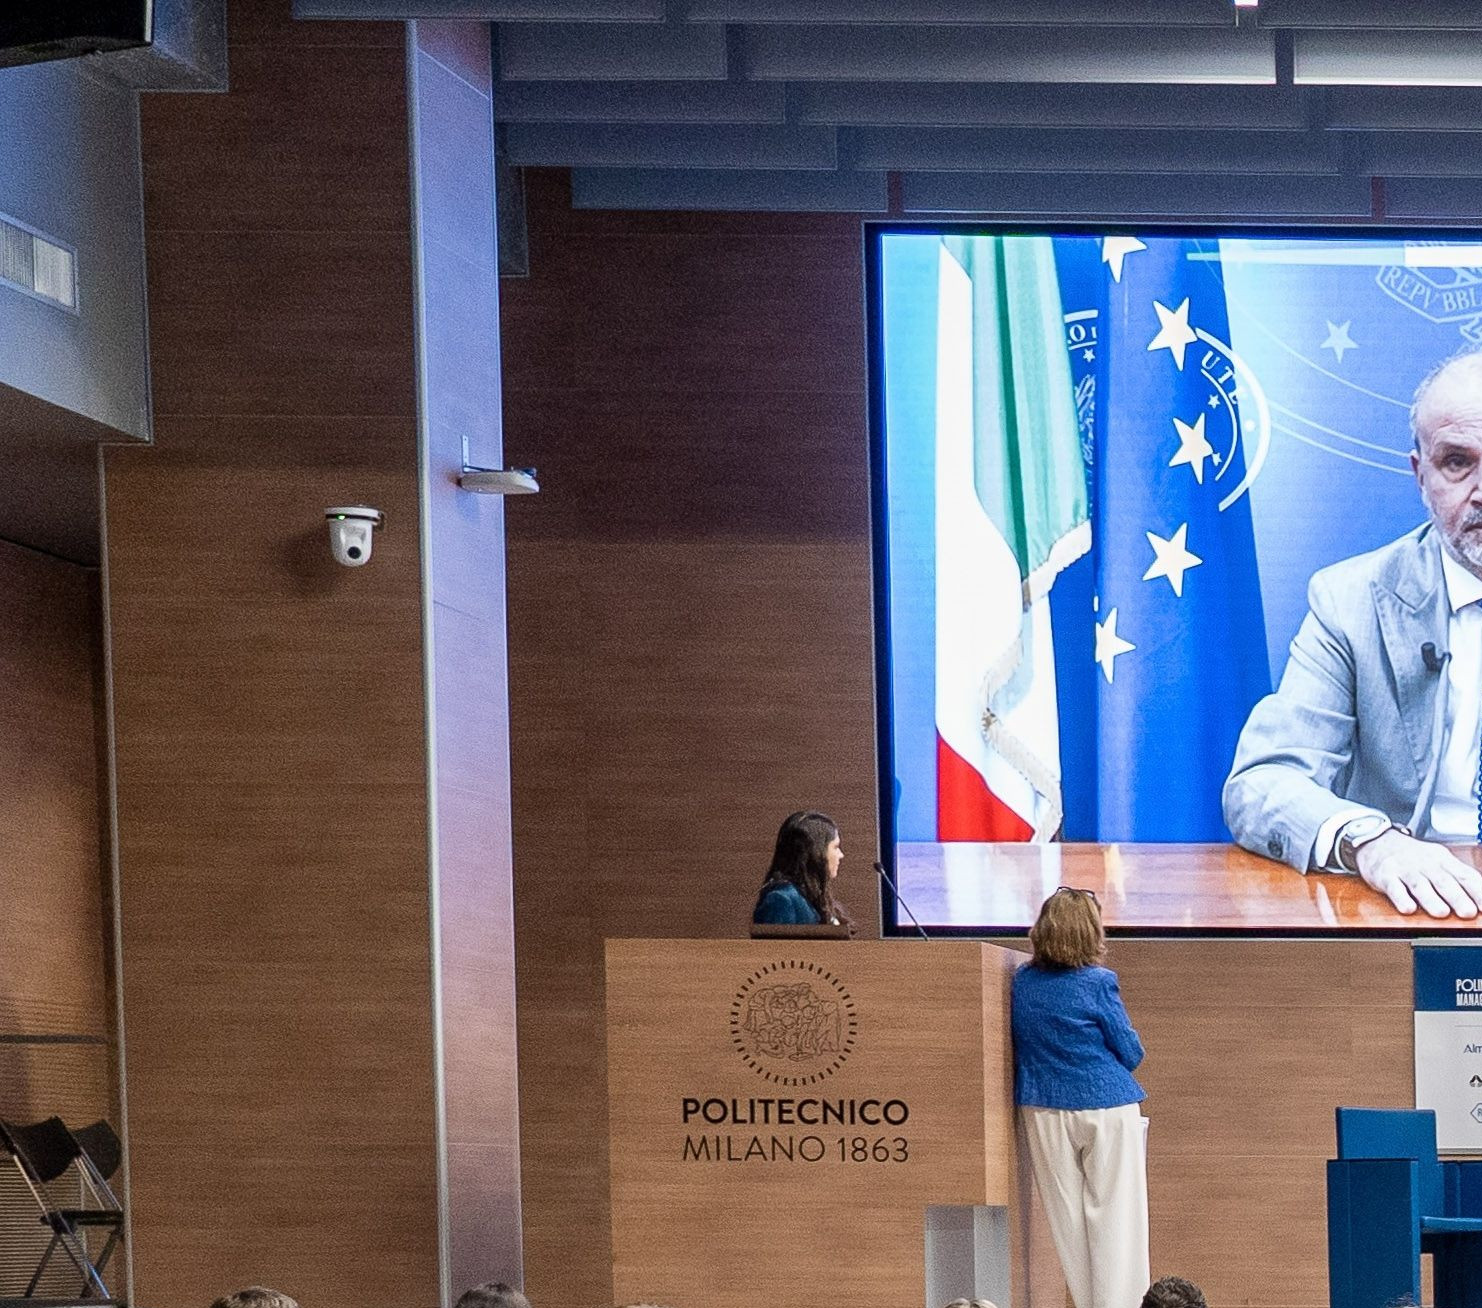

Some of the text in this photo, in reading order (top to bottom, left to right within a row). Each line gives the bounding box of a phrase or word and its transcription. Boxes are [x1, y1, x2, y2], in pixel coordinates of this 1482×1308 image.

[682, 1098, 909, 1125] POLITECNICO
[682, 1136, 909, 1162] MILANO 1863
